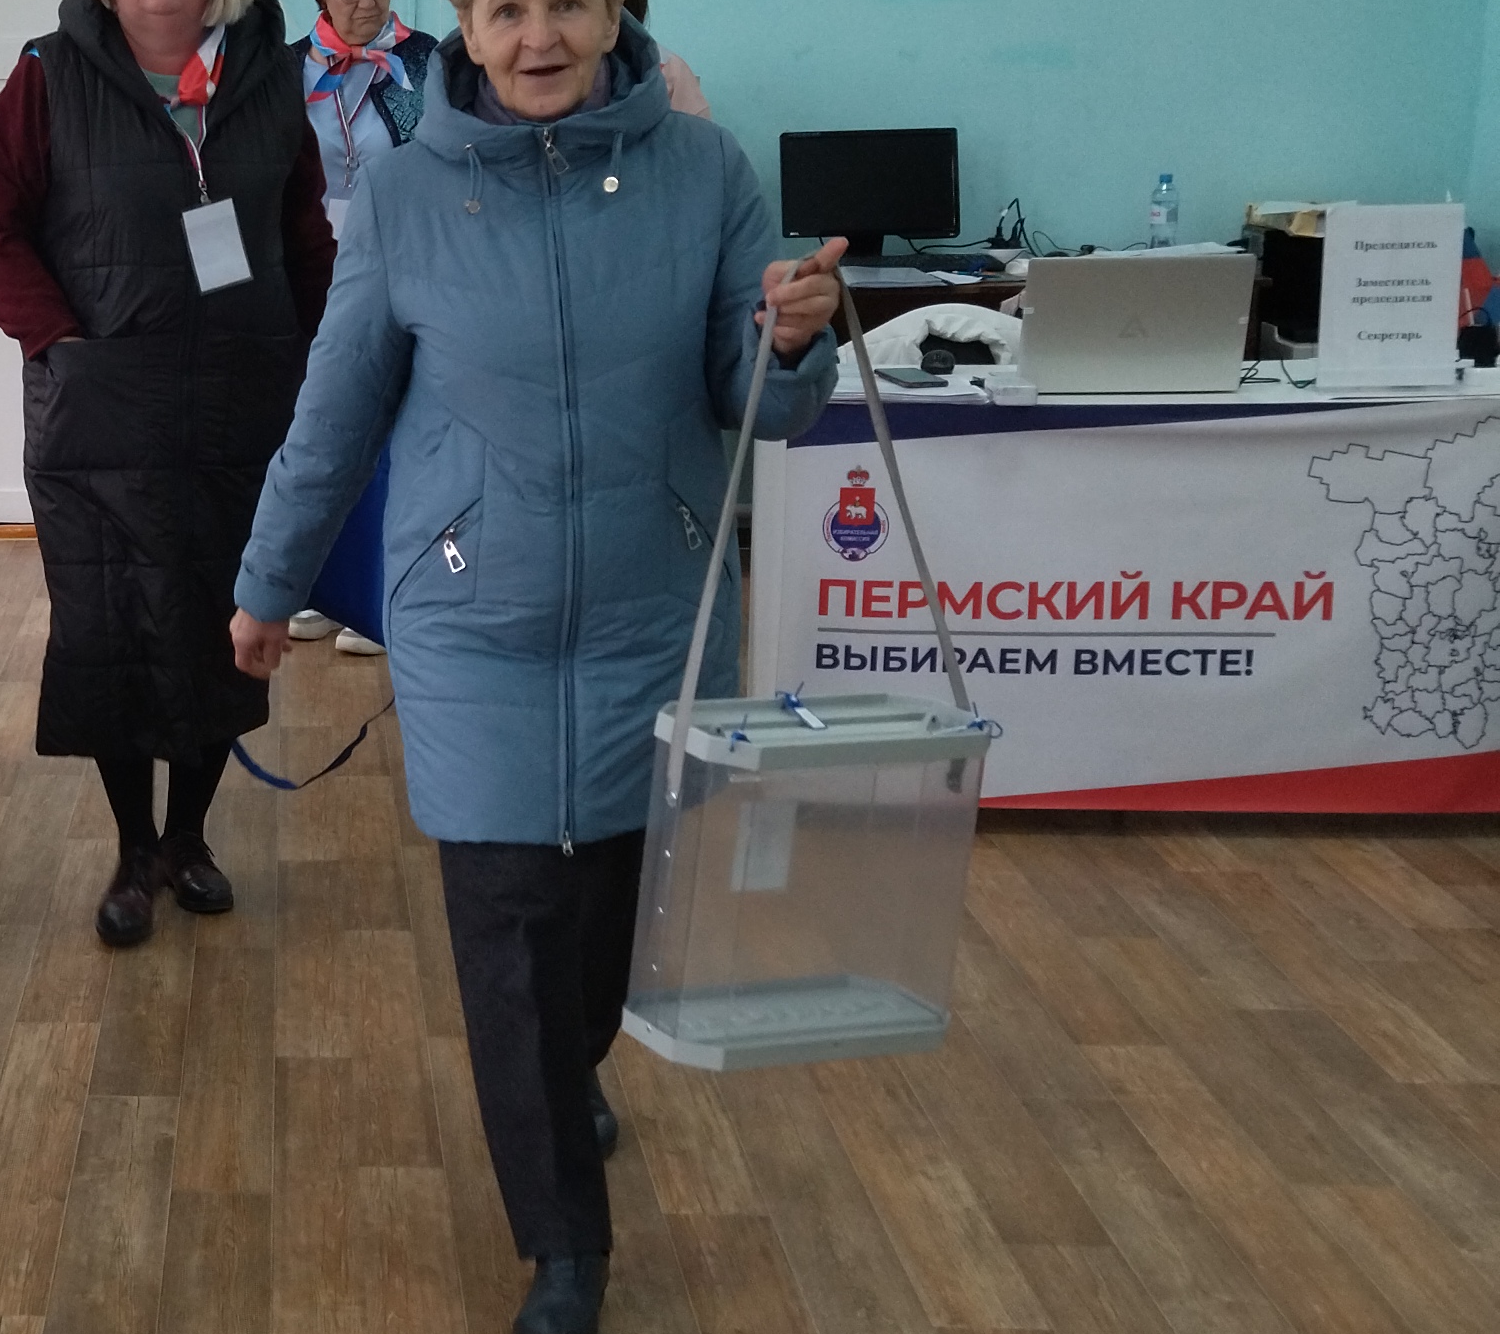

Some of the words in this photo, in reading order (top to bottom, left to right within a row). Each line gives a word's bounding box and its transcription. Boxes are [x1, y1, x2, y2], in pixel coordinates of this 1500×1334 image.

[1354, 240, 1438, 252] Председатель
[1356, 277, 1432, 287] Заместитель
[1352, 295, 1433, 306] председателя
[1357, 330, 1422, 342] Секретарь
[818, 570, 1151, 621] ПЕРМСКИЙ
[1171, 571, 1335, 622] КРАЙ
[815, 643, 1059, 675] ВЫБИРАЕМ
[1073, 648, 1253, 676] ВМЕСТЕ!
